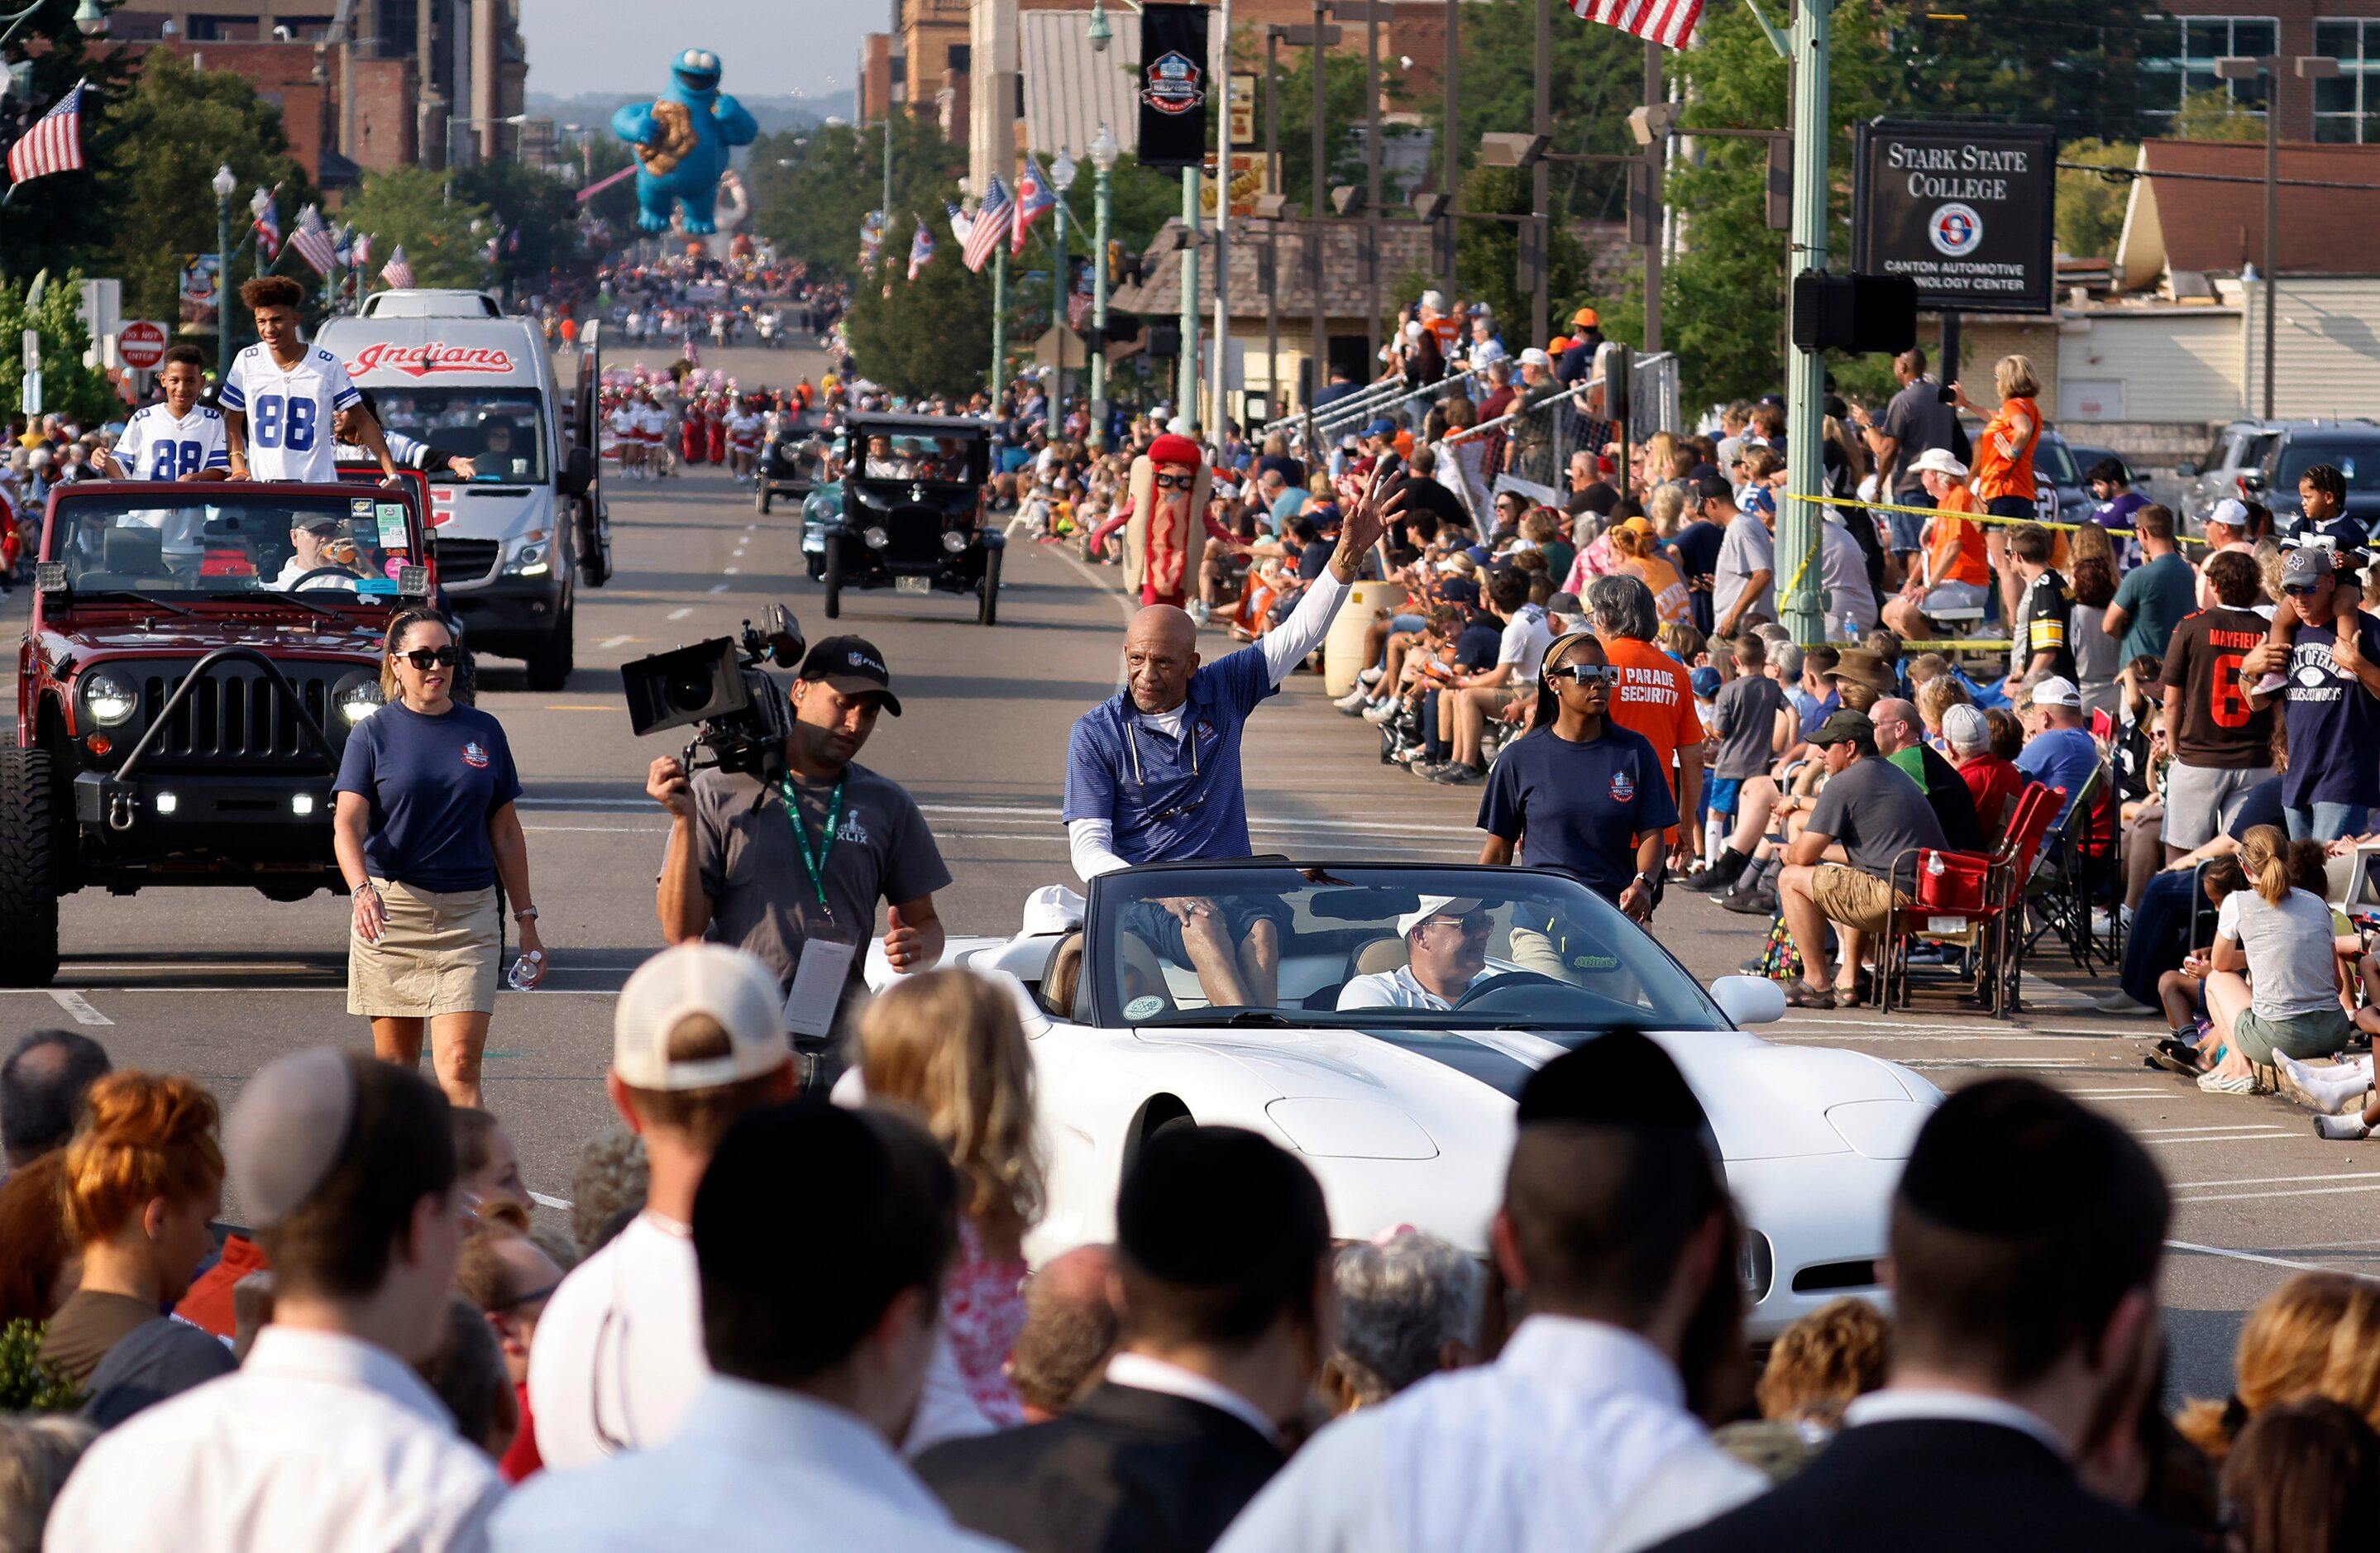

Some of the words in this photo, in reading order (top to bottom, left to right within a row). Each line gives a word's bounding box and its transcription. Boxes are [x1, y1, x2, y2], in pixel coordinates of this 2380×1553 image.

[1907, 171, 2007, 200] COLLEGE
[1884, 260, 1938, 273] CANTON
[1940, 261, 2024, 275] AUTOMOTIVE
[1972, 277, 2024, 289] CENTER
[125, 331, 137, 339] DO
[141, 331, 159, 339] NOT
[127, 351, 155, 361] ENTER
[343, 341, 515, 380] Indians
[255, 394, 317, 452] 88
[151, 439, 203, 481] 88
[1625, 667, 1675, 689] PARADE
[1620, 686, 1679, 707] SECURITY
[2211, 654, 2251, 728] 6
[827, 815, 836, 832] MEDIA
[836, 831, 867, 844] XLIX
